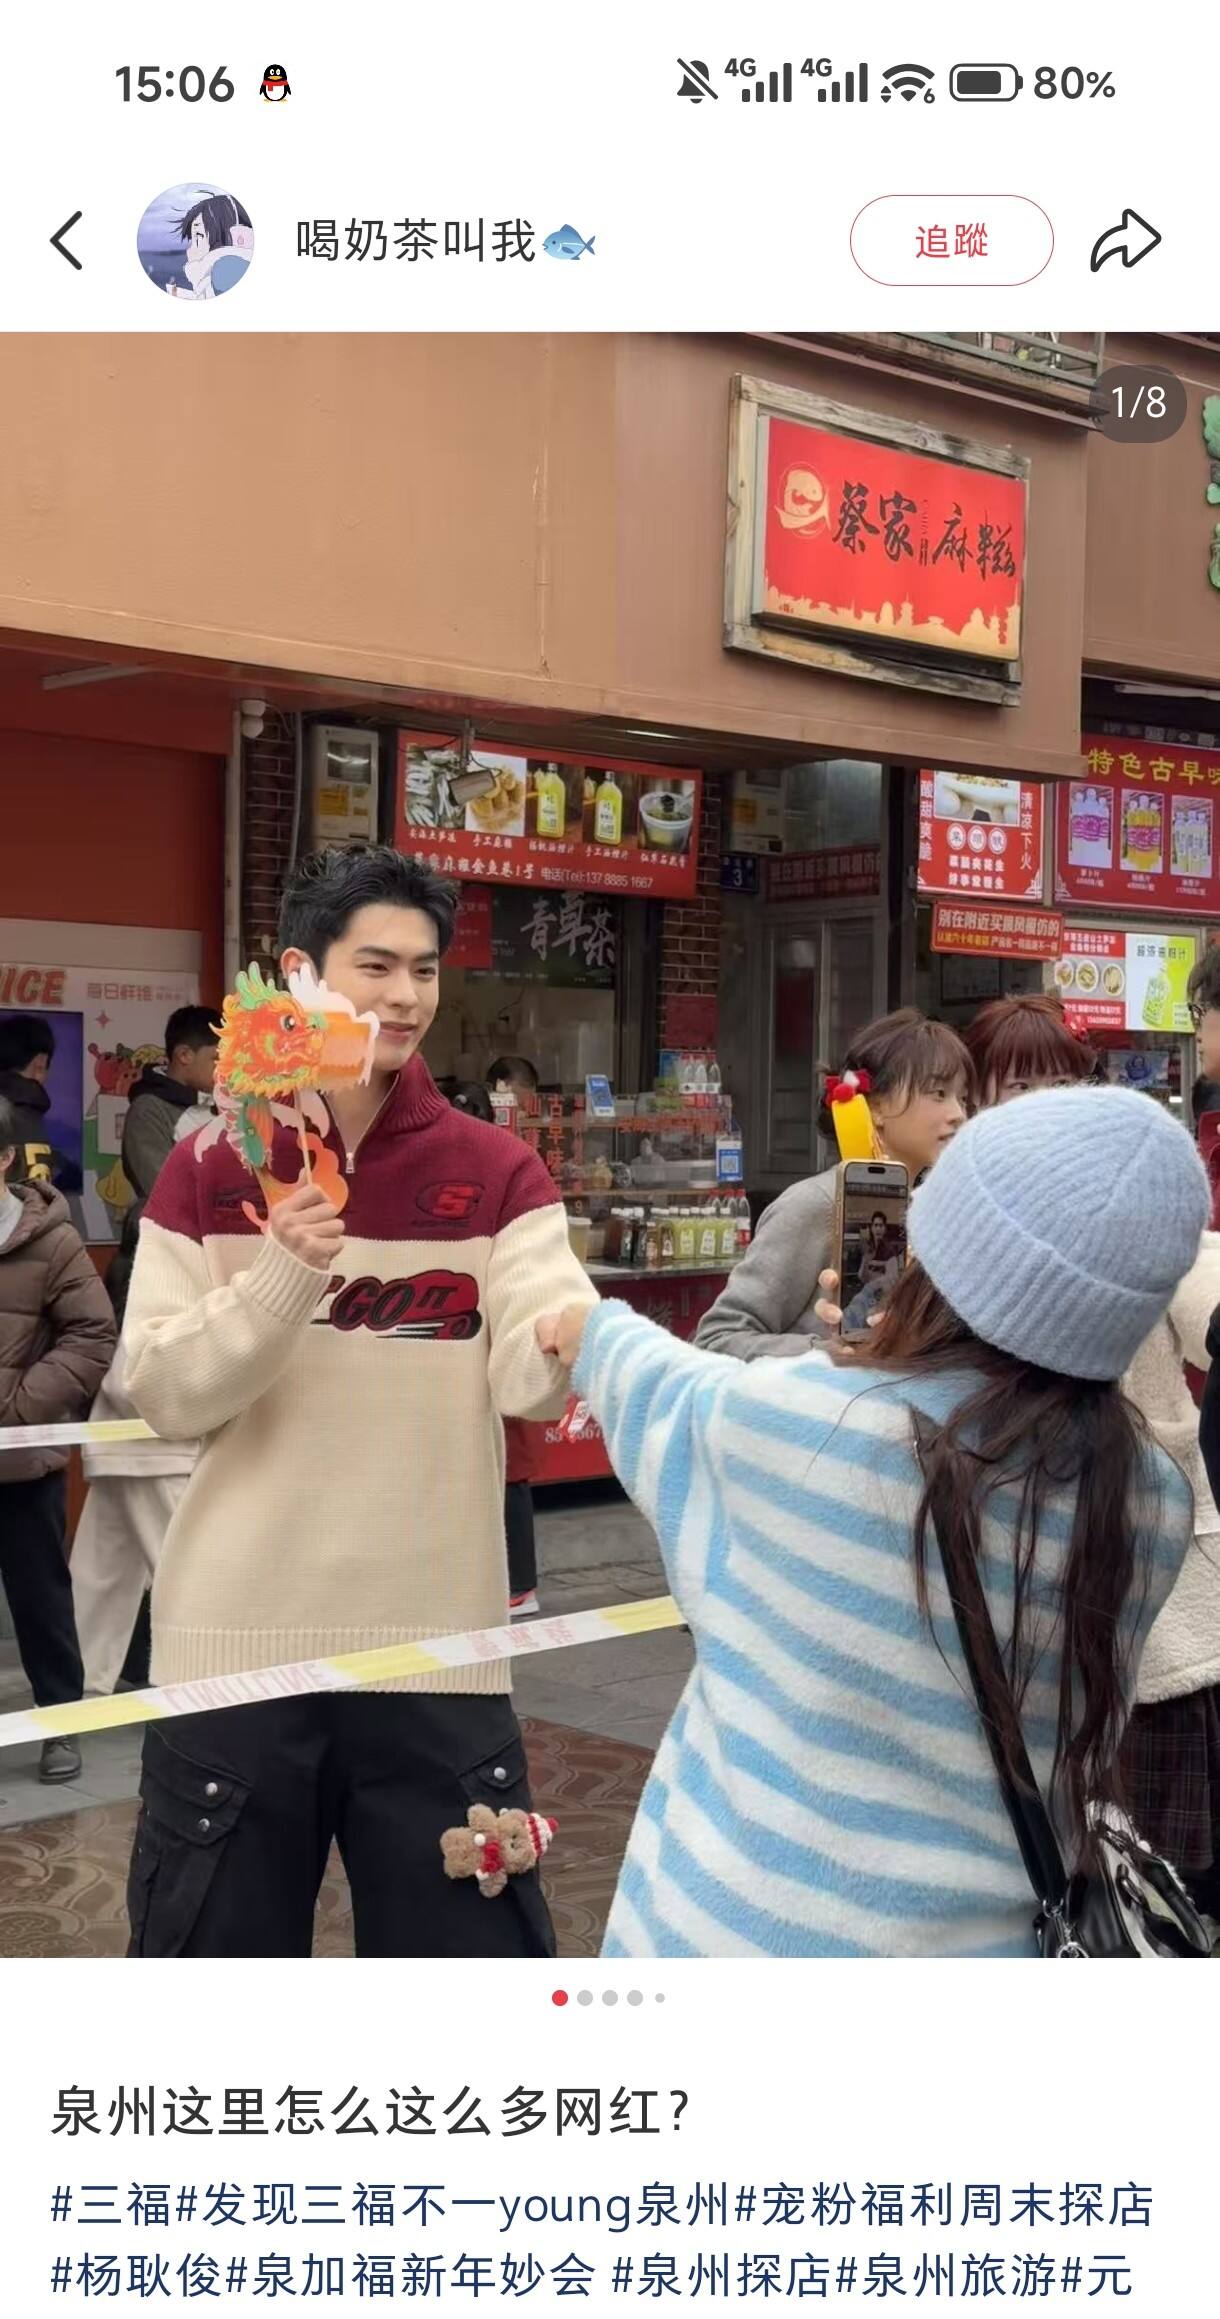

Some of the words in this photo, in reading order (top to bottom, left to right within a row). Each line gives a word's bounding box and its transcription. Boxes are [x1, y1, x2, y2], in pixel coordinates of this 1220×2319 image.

[1020, 791, 1033, 870] 清凉下火
[520, 889, 616, 967] 青草茶
[0, 967, 66, 1005] ICE
